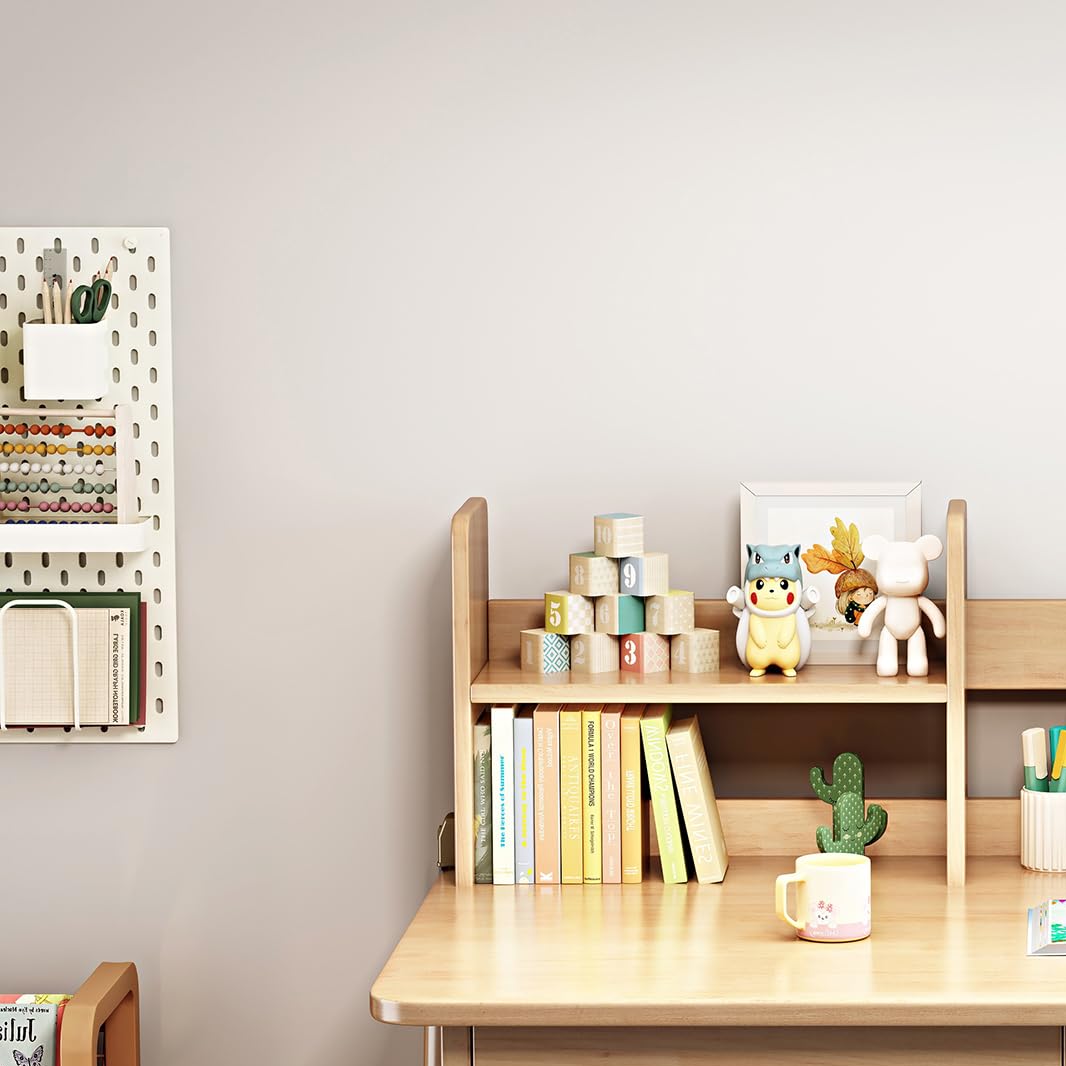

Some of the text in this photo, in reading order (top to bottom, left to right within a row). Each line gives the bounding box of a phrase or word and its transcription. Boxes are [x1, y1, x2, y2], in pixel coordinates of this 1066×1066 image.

[595, 526, 612, 544] 10
[574, 564, 584, 585] 8
[623, 563, 637, 588] 9
[549, 601, 561, 627] 5
[600, 602, 609, 624] 6
[651, 602, 661, 626] 7
[525, 640, 533, 664] 1
[574, 640, 585, 664] 2
[624, 640, 637, 665] 3
[673, 640, 686, 665] 4
[587, 720, 595, 748] FORMULA
[567, 754, 579, 840] ANTIQUAIRES
[588, 774, 596, 807] CHAMPIONS
